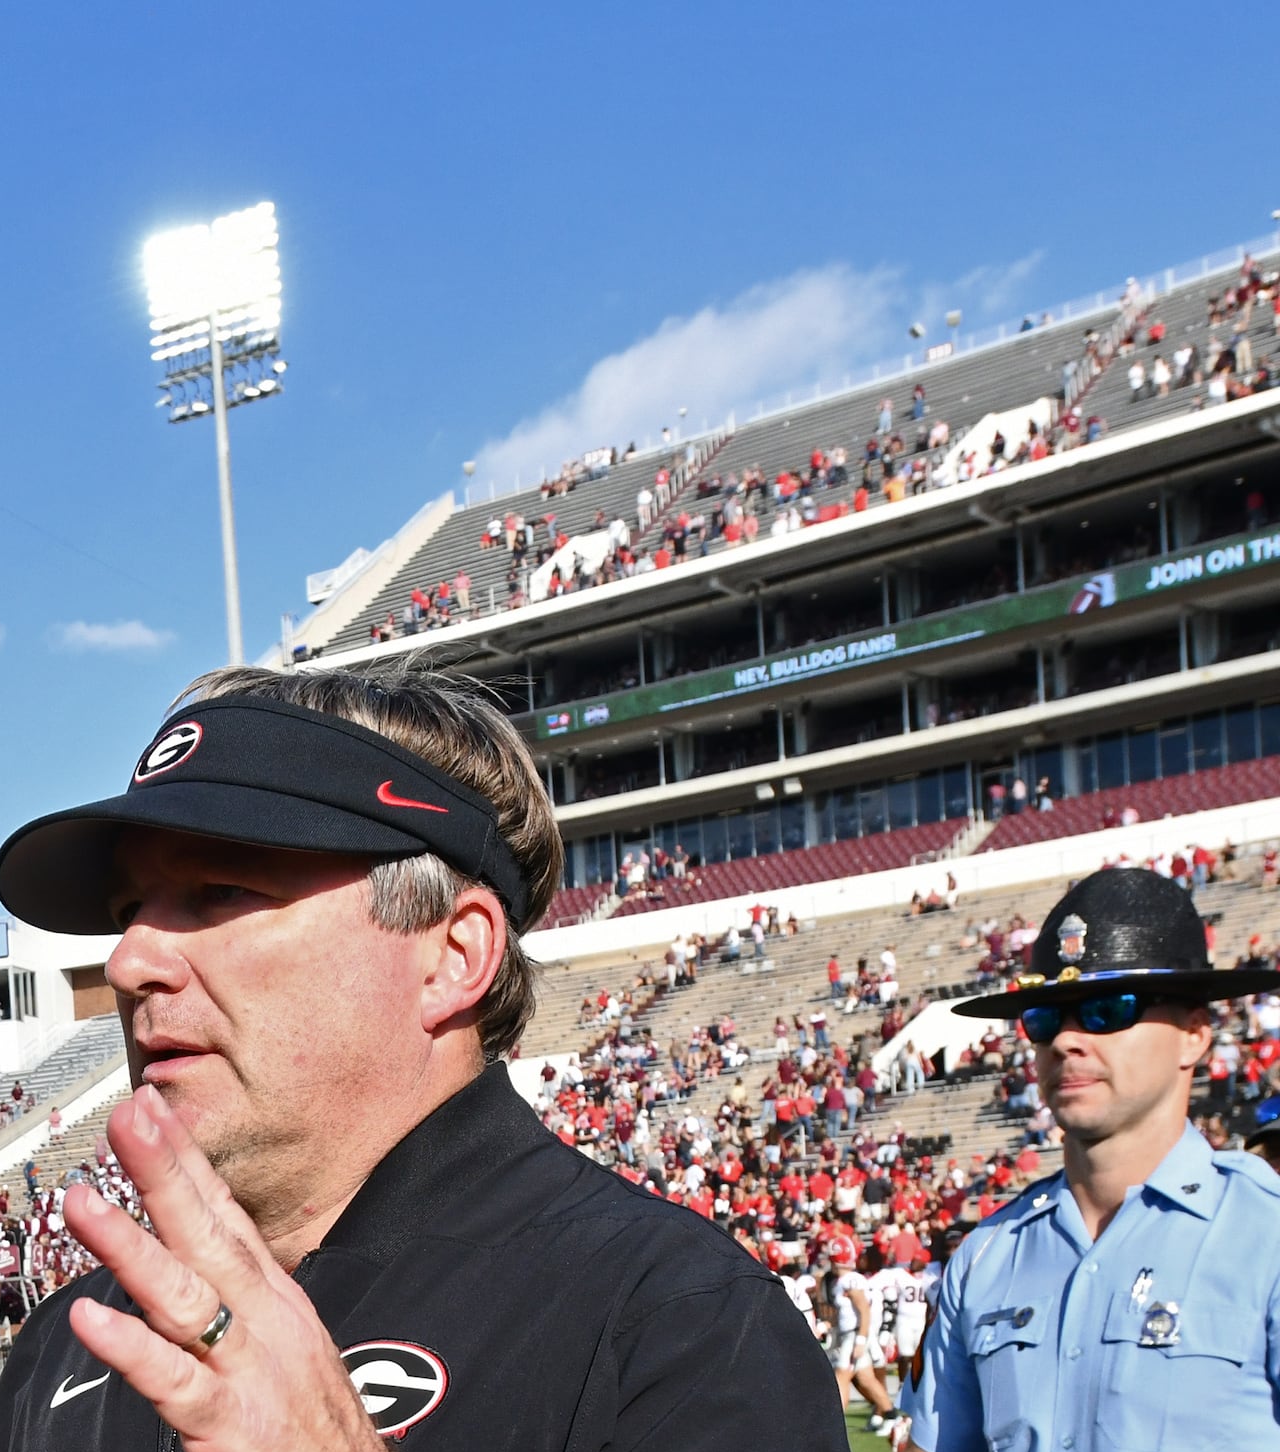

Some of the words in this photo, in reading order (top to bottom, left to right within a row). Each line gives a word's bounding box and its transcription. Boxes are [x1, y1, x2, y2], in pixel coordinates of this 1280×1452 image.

[1145, 555, 1202, 590] JOIN
[1206, 544, 1244, 573] ON
[734, 665, 769, 687] HEY,
[770, 645, 846, 679] BULLDOG
[848, 633, 897, 660] FANS!
